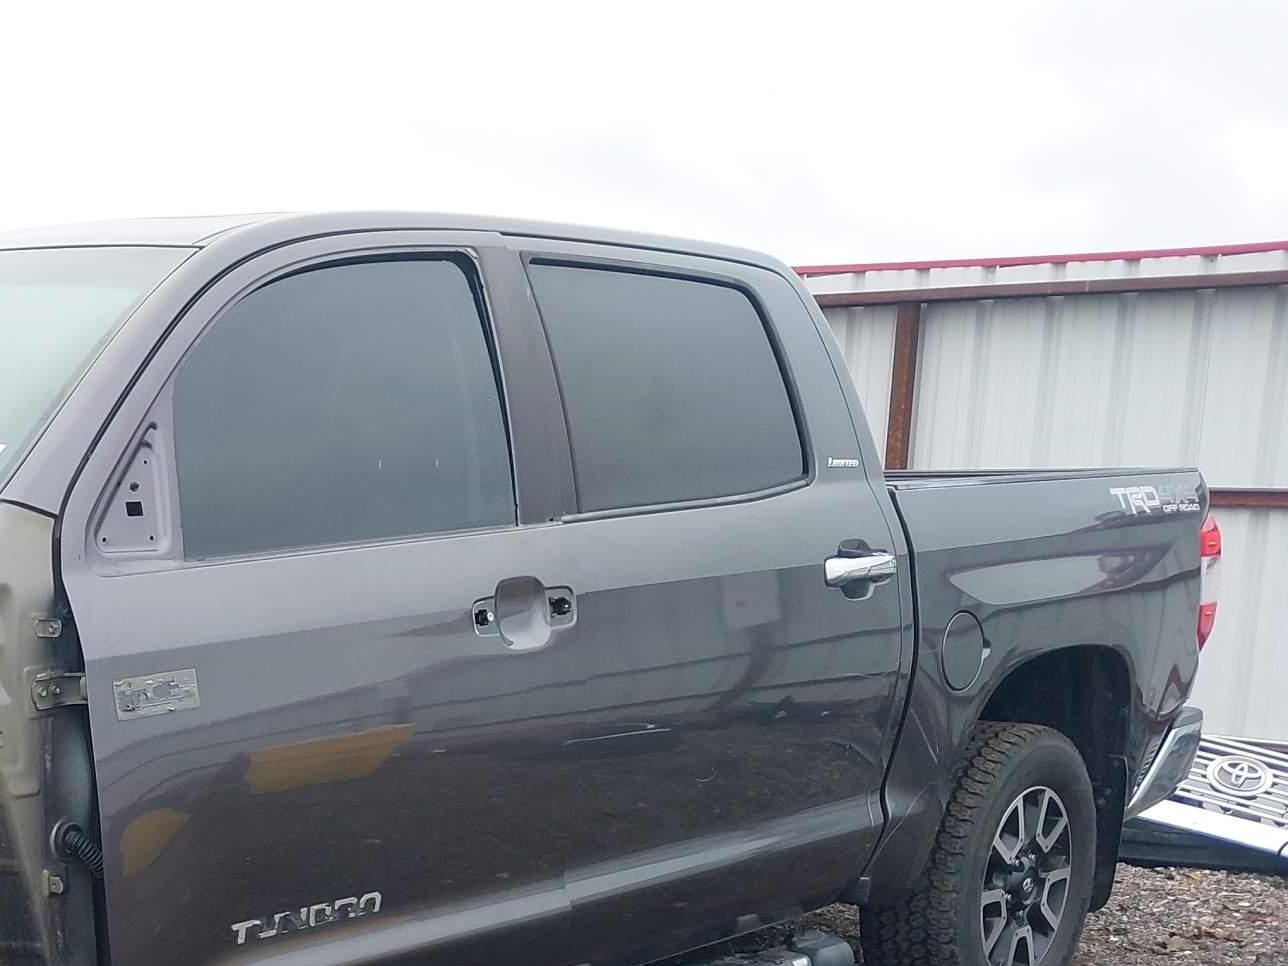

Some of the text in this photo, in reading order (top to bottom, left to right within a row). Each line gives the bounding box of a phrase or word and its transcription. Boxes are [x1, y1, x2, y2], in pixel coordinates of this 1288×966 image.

[1109, 486, 1160, 514] TRD
[1162, 503, 1200, 512] OFF ROAD
[231, 891, 382, 944] TUNDRA
